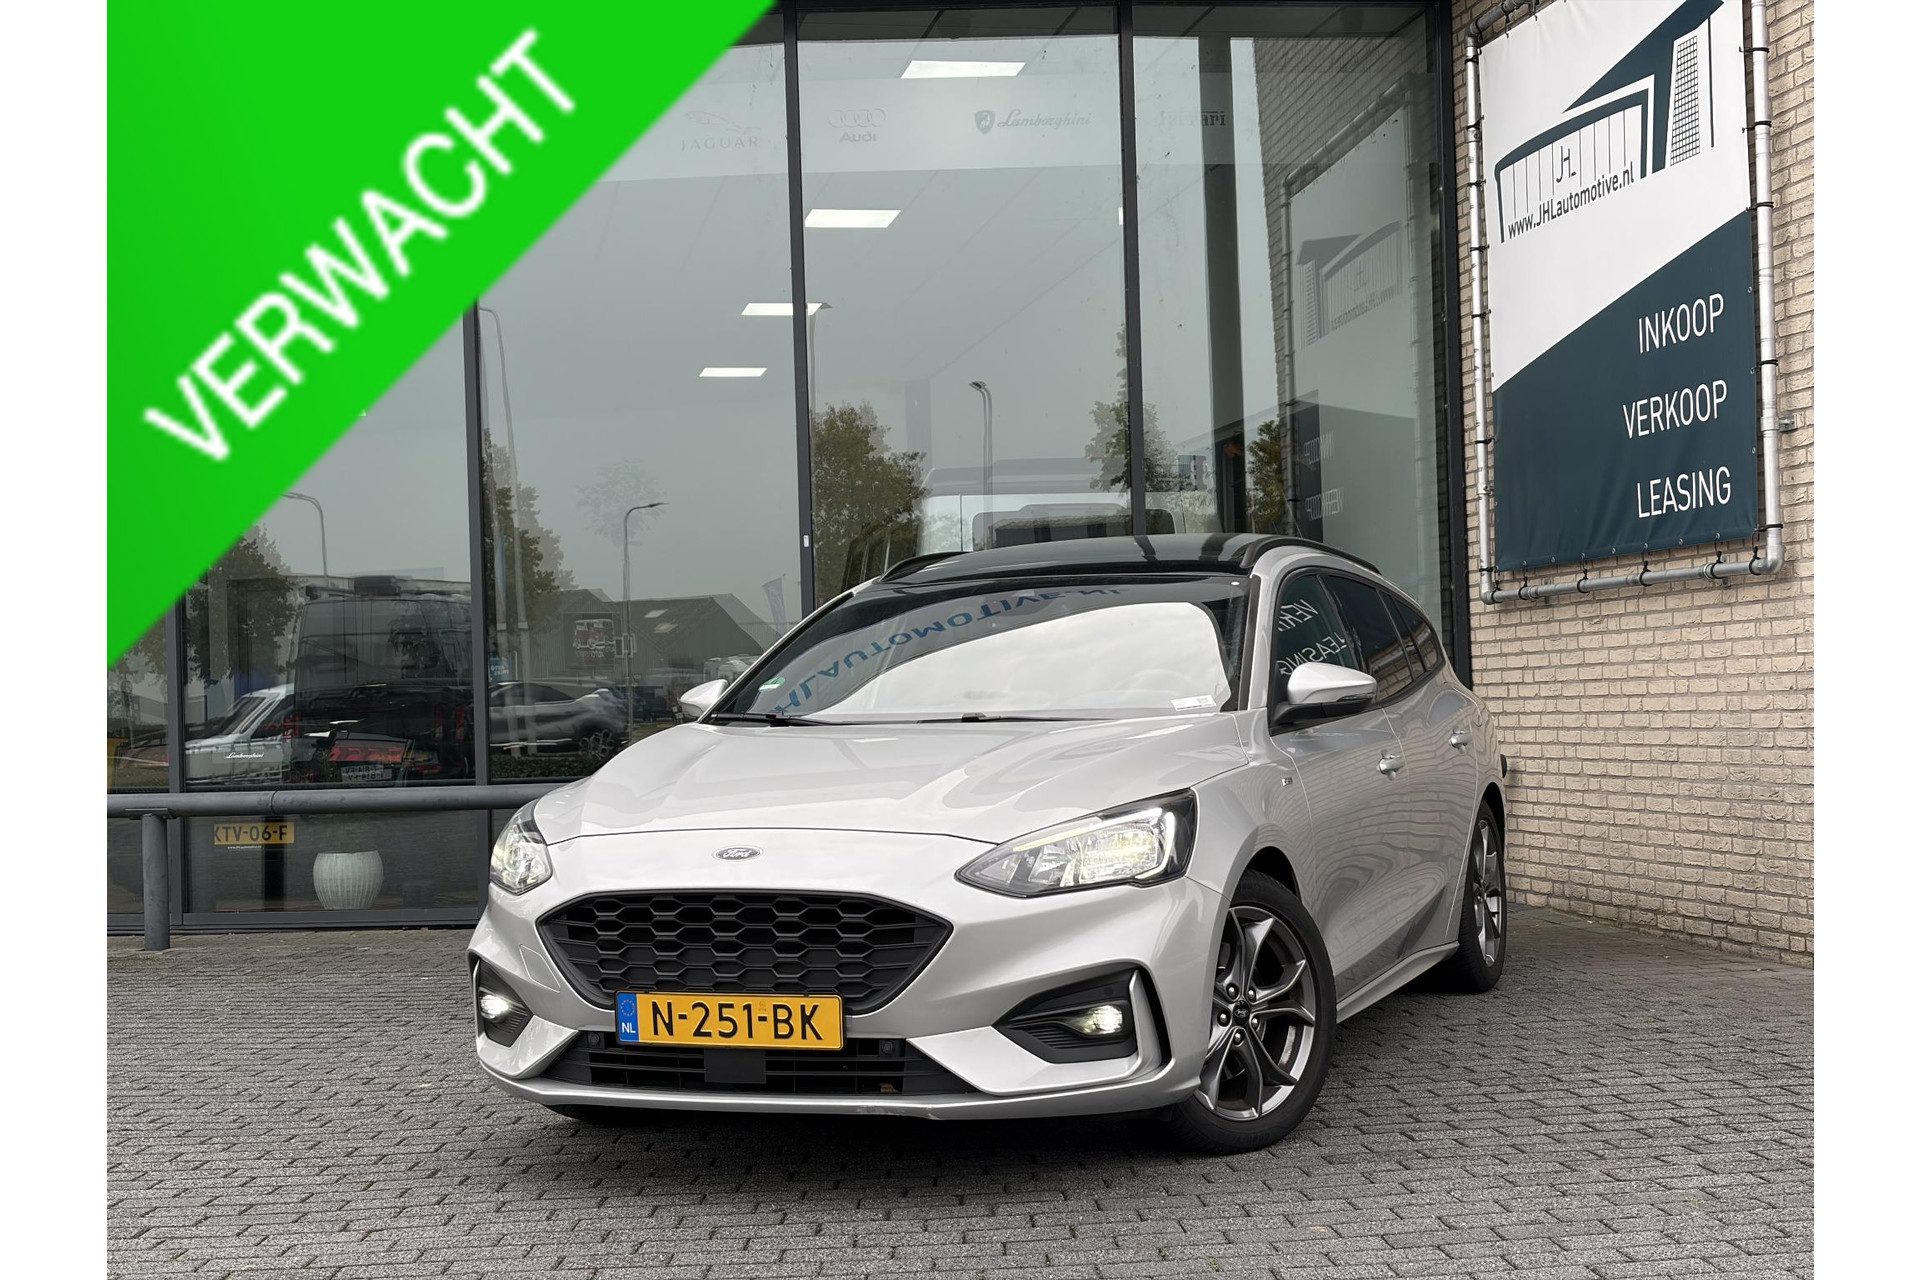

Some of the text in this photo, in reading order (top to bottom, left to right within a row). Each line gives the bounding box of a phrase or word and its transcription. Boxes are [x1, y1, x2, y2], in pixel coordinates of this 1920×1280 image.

[998, 108, 1092, 130] Lamborghini
[681, 135, 761, 153] JAGUAR
[838, 131, 877, 144] Audi
[1508, 161, 1635, 240] www.JHLautomotive.nl
[1637, 293, 1725, 355] INKOOP
[1622, 379, 1729, 440] VERKOOP
[1636, 466, 1732, 519] LEASING
[723, 847, 753, 859] Ford
[621, 1021, 637, 1035] NL
[651, 1000, 825, 1041] N-251-BK
